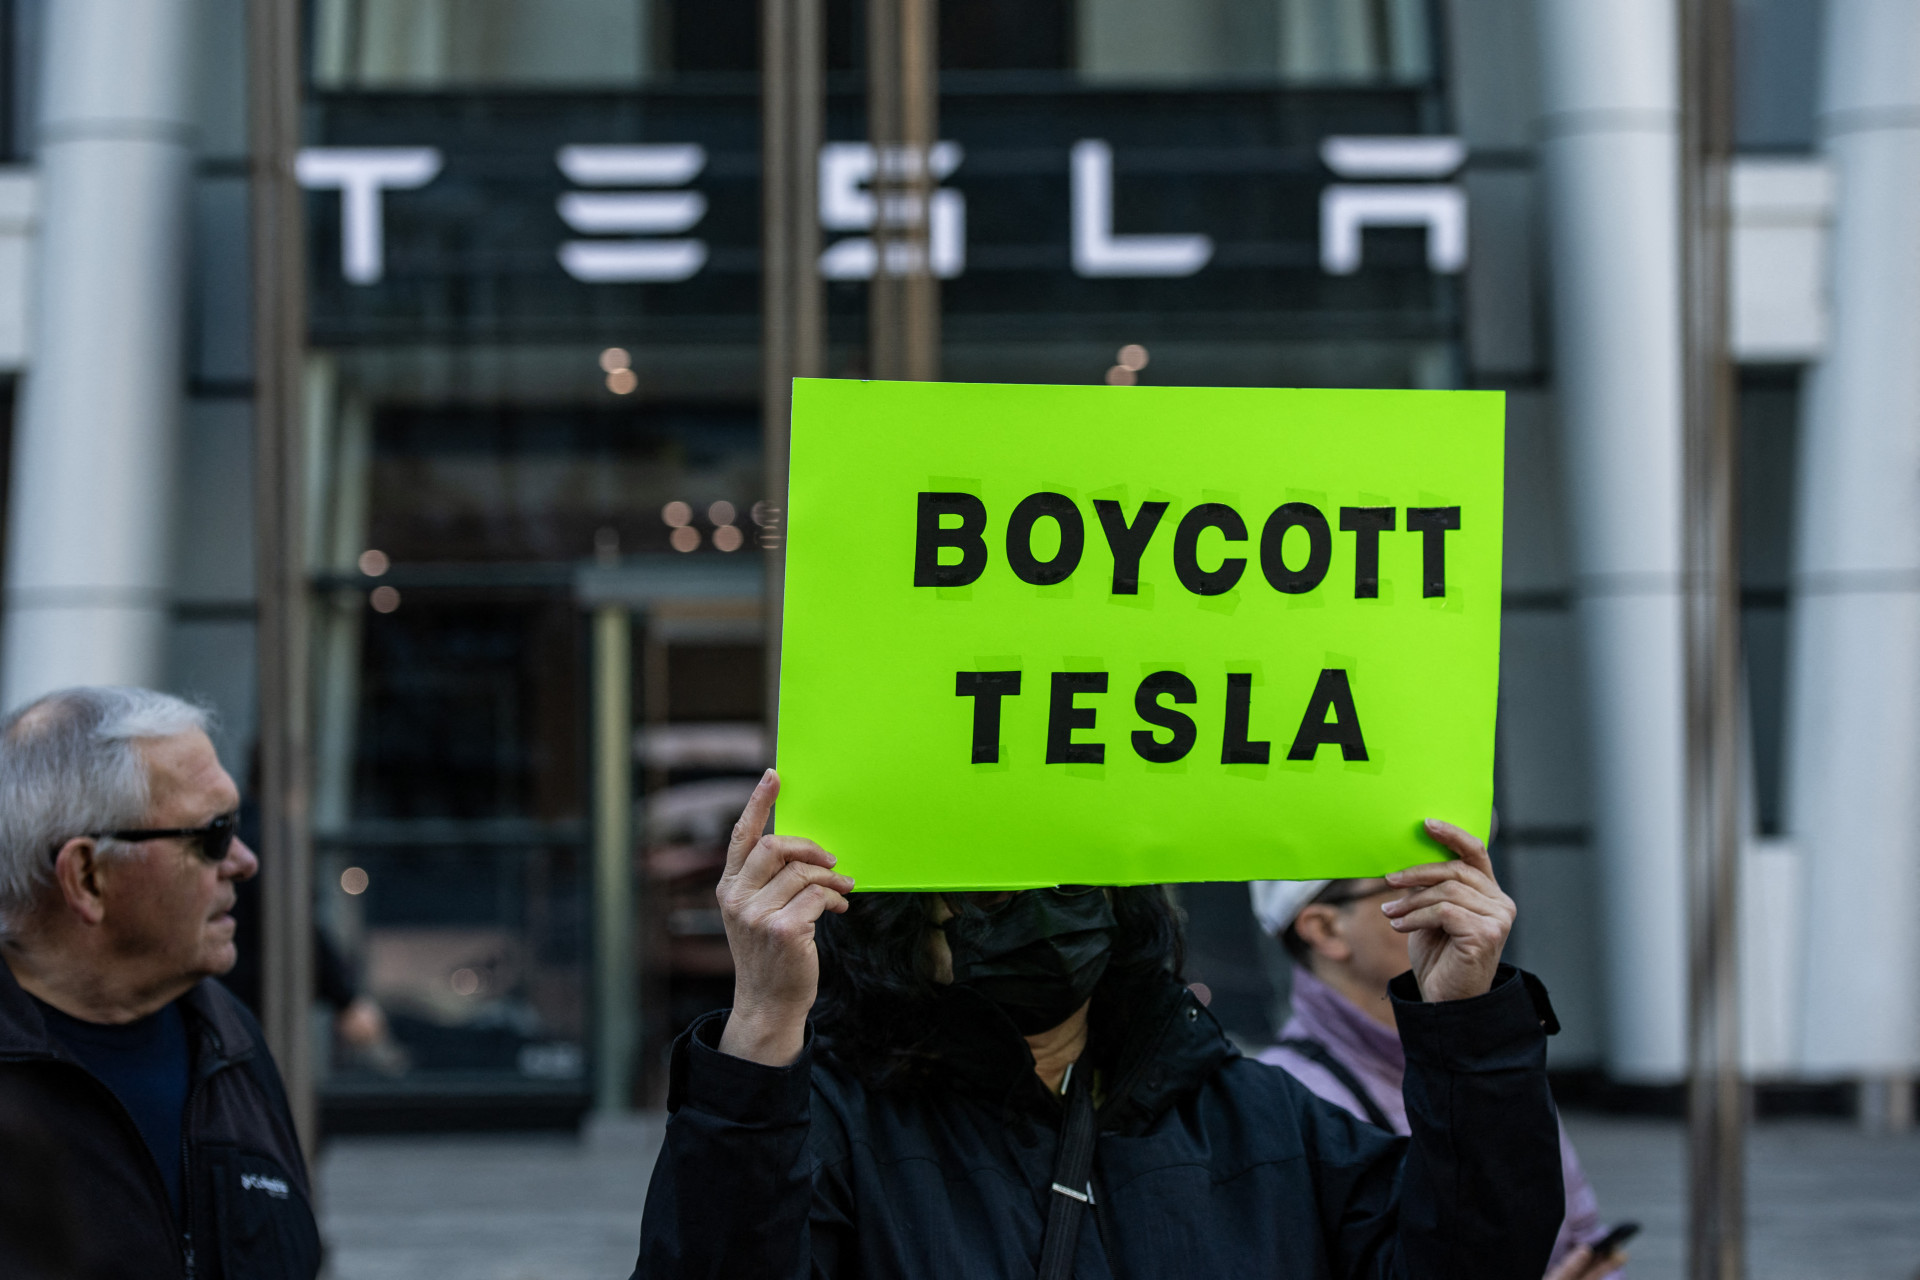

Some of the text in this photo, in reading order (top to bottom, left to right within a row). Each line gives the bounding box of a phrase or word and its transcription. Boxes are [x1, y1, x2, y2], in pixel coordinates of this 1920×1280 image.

[296, 138, 1467, 284] TESLA
[914, 491, 1461, 599] BOYCOTT
[956, 669, 1369, 765] TESLA
